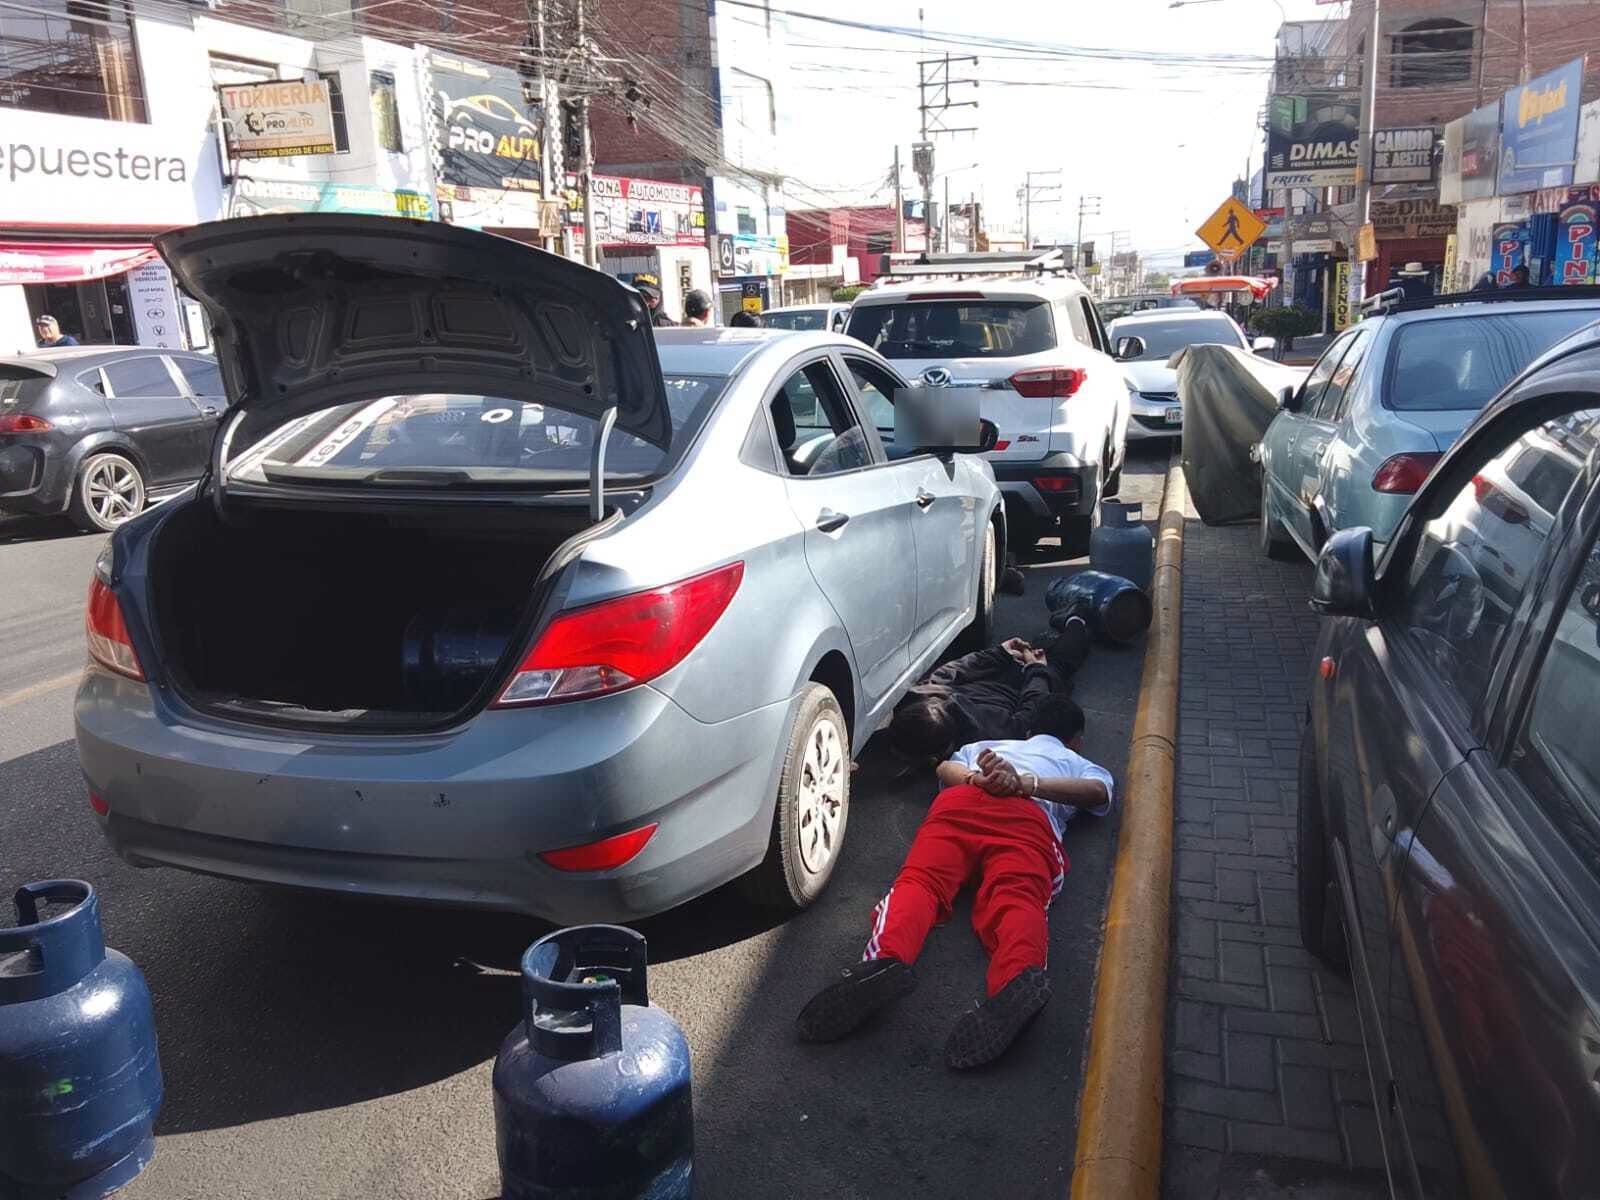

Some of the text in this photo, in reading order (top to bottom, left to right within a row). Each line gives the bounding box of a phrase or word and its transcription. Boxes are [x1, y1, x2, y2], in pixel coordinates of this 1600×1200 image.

[225, 84, 325, 110] TORNERIA
[266, 119, 285, 129] PRO
[448, 126, 495, 155] PRO
[1289, 140, 1360, 161] DIMAS
[0, 144, 186, 182] puestera
[629, 182, 689, 201] AUTOMOTRIZ
[1272, 174, 1316, 186] FRITEC
[1562, 224, 1593, 285] PIN
[1337, 263, 1350, 325] FRENOS
